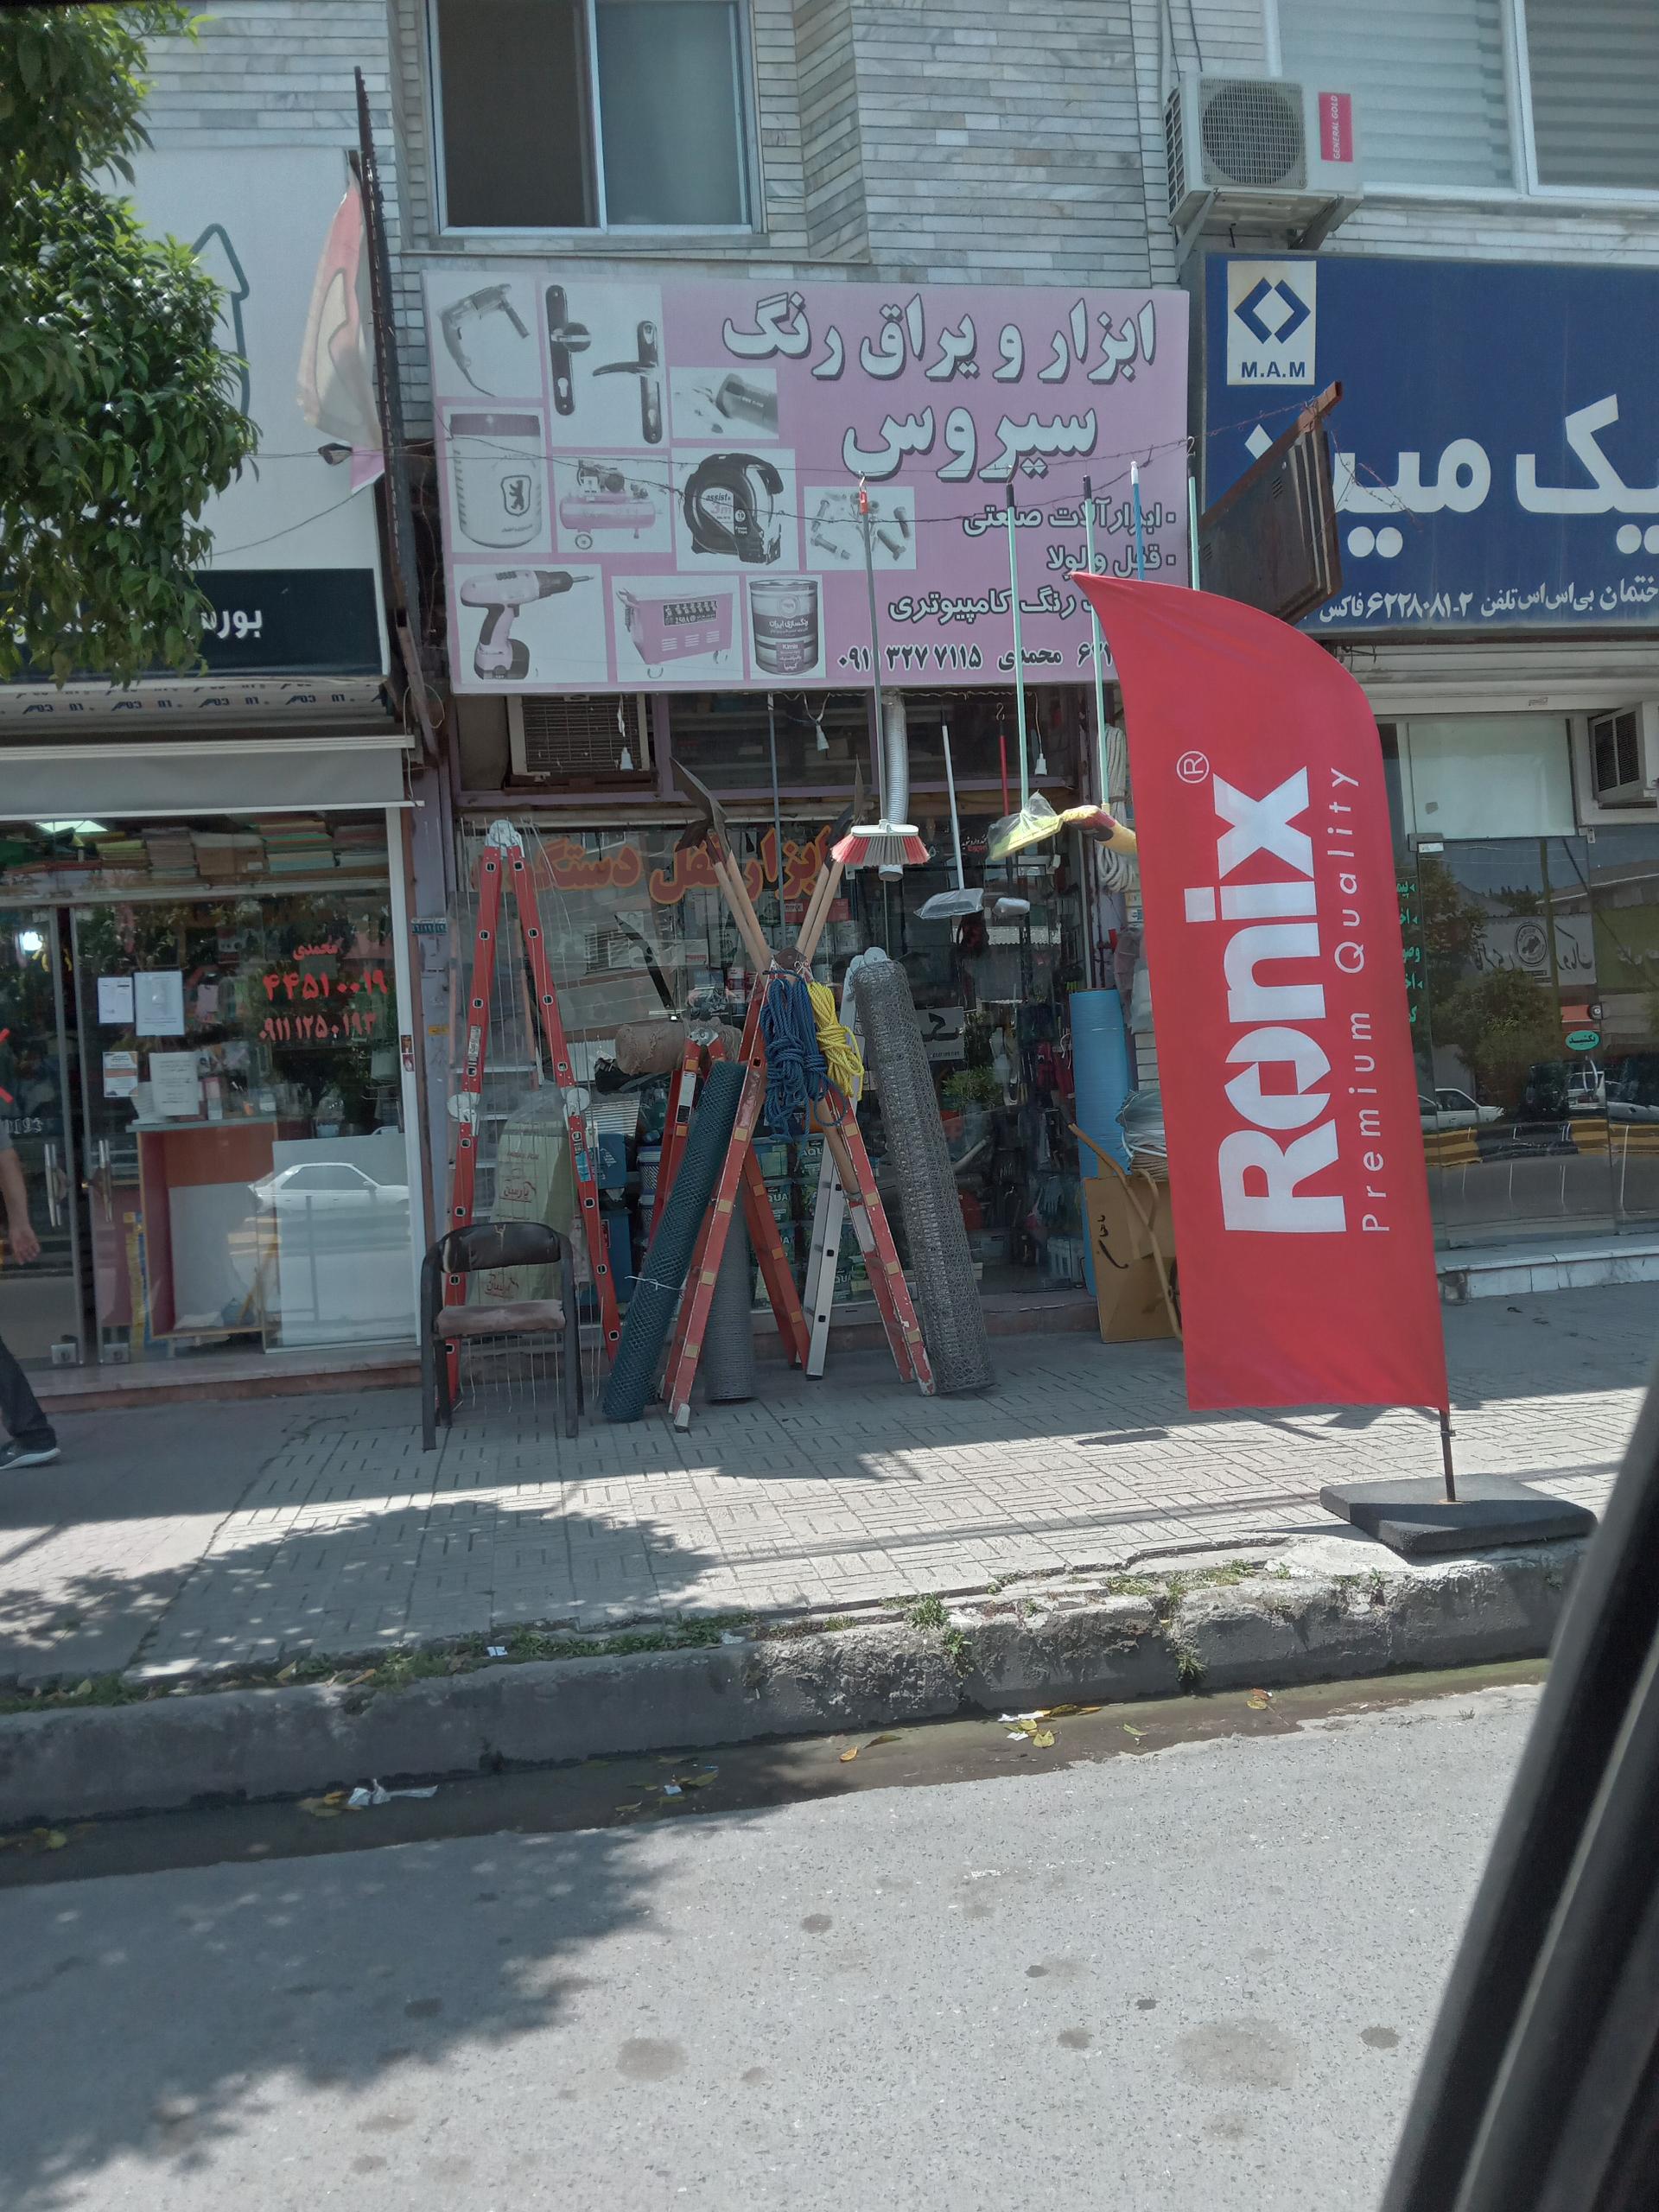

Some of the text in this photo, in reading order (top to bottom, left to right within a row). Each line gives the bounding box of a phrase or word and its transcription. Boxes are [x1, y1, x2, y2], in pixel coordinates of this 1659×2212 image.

[1331, 95, 1339, 118] GOLD
[722, 291, 1156, 384] ابزار و یراق رنگ
[1241, 360, 1306, 378] M.A.M
[842, 404, 1098, 483] سیروس
[963, 495, 1163, 537] ابارآلات صعتی
[889, 588, 1014, 624] کامپیوتری
[1019, 586, 1077, 620] رنگ
[293, 944, 340, 961] محمدی
[1184, 766, 1347, 1233] Ronix
[1327, 766, 1389, 1232] Premium Quality
